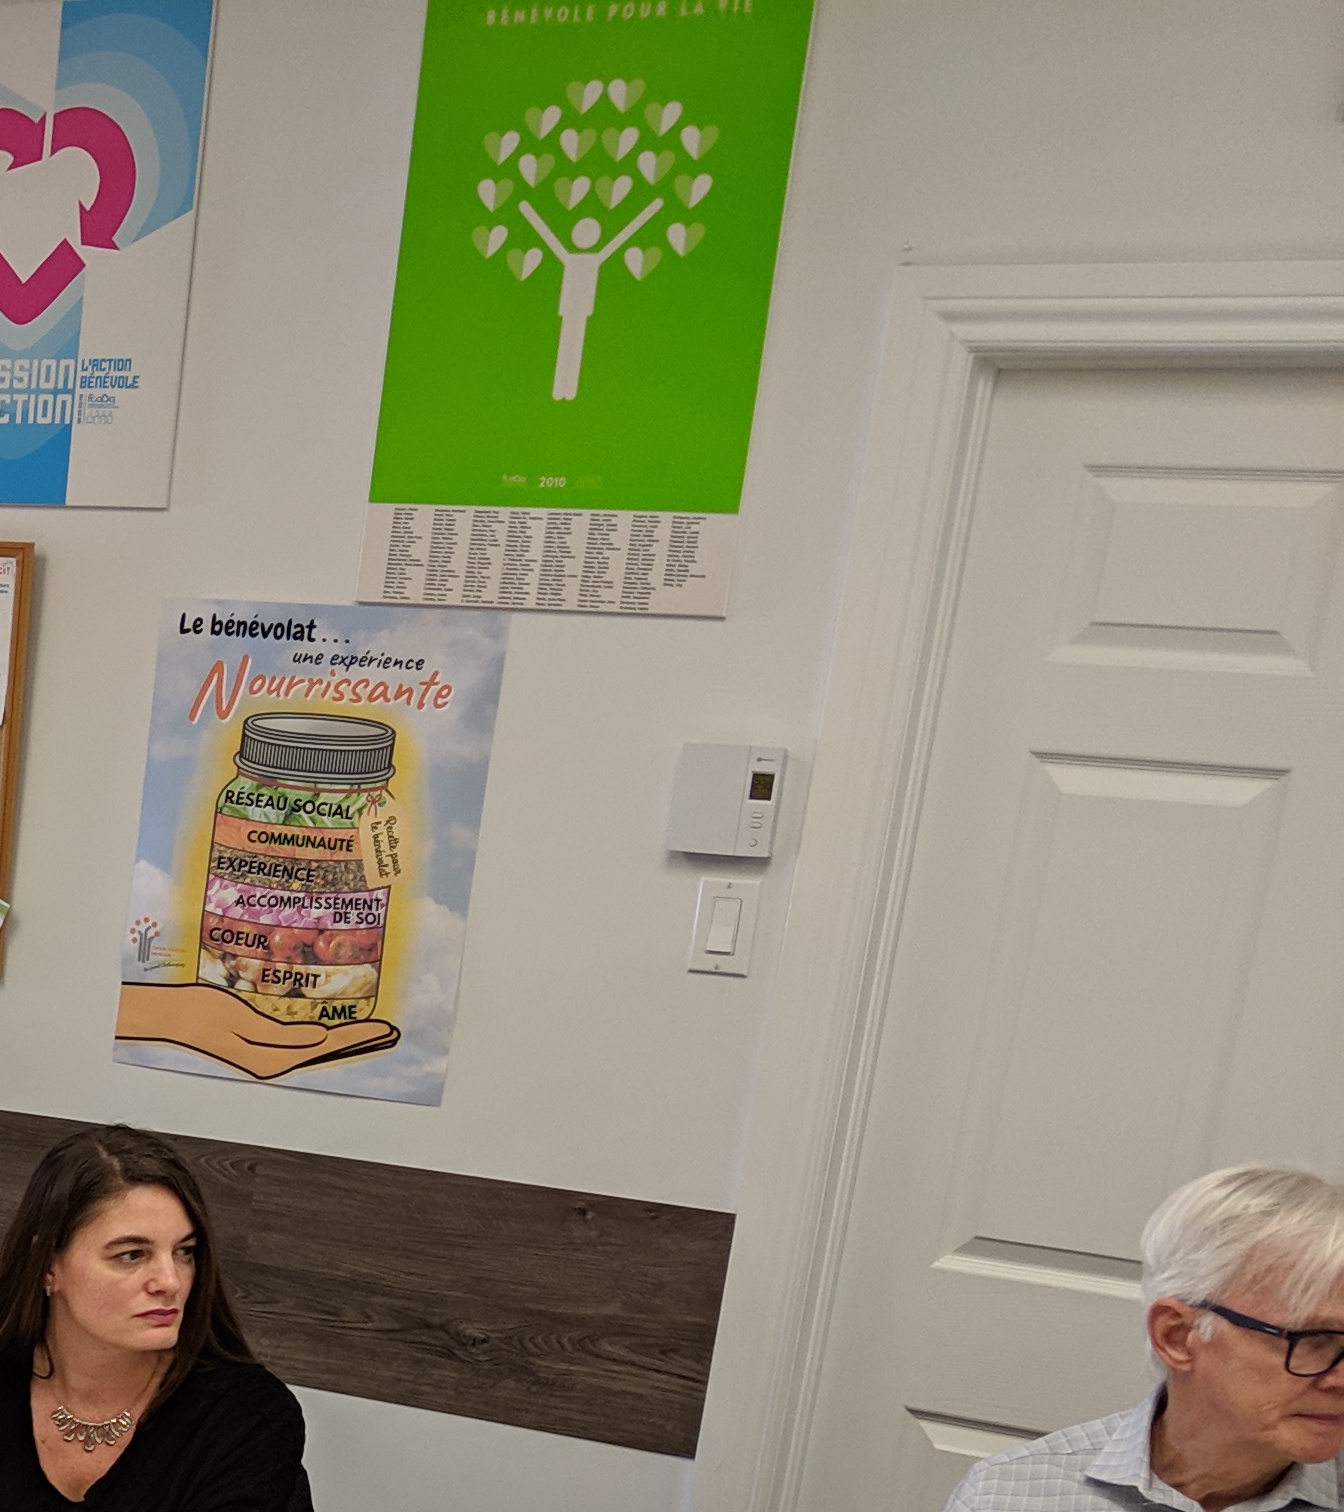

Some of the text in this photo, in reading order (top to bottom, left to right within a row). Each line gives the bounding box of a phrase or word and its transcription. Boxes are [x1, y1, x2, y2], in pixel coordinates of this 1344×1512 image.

[485, 3, 596, 27] BÉNÉVOLE
[607, 1, 667, 21] POUR
[80, 357, 133, 373] L'ACTION
[79, 372, 140, 390] BÉNÉVOLE
[538, 475, 567, 489] 2010
[179, 611, 205, 635] Le
[292, 649, 426, 673] une expérience
[187, 652, 454, 725] Nourrissante
[224, 787, 354, 821] RÉSEAU SOCIAL
[246, 829, 355, 853] COMMUNAUTÉ
[216, 854, 316, 884] EXPÉRIENCE
[234, 893, 383, 912] ACCOMPLISSEMENT
[332, 911, 382, 926] DE SOI
[209, 927, 269, 950] COEUR
[261, 968, 322, 989] ESPRIT
[317, 1001, 357, 1021] ÂME
